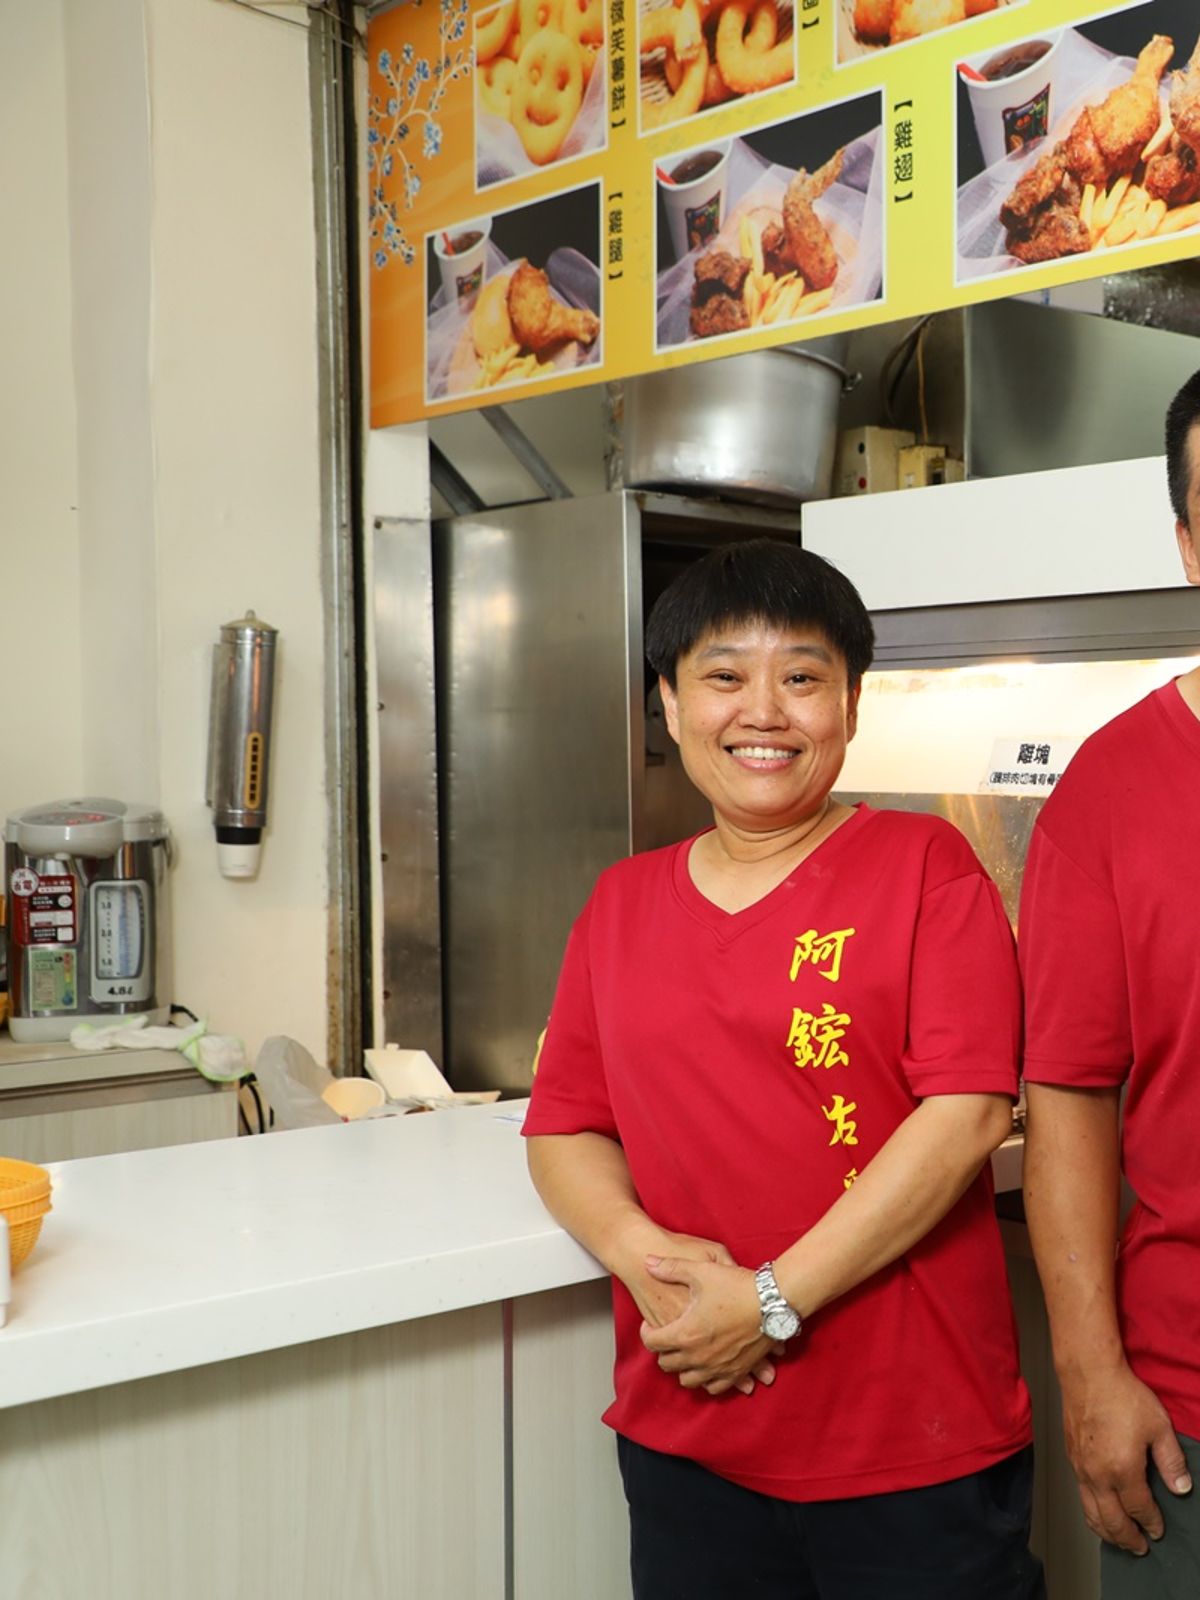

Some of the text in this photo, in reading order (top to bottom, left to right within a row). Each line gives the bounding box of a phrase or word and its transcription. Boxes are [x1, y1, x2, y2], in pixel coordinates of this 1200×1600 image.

[1017, 743, 1051, 765] 雞塊
[785, 927, 859, 1190] 阿鋐炸
